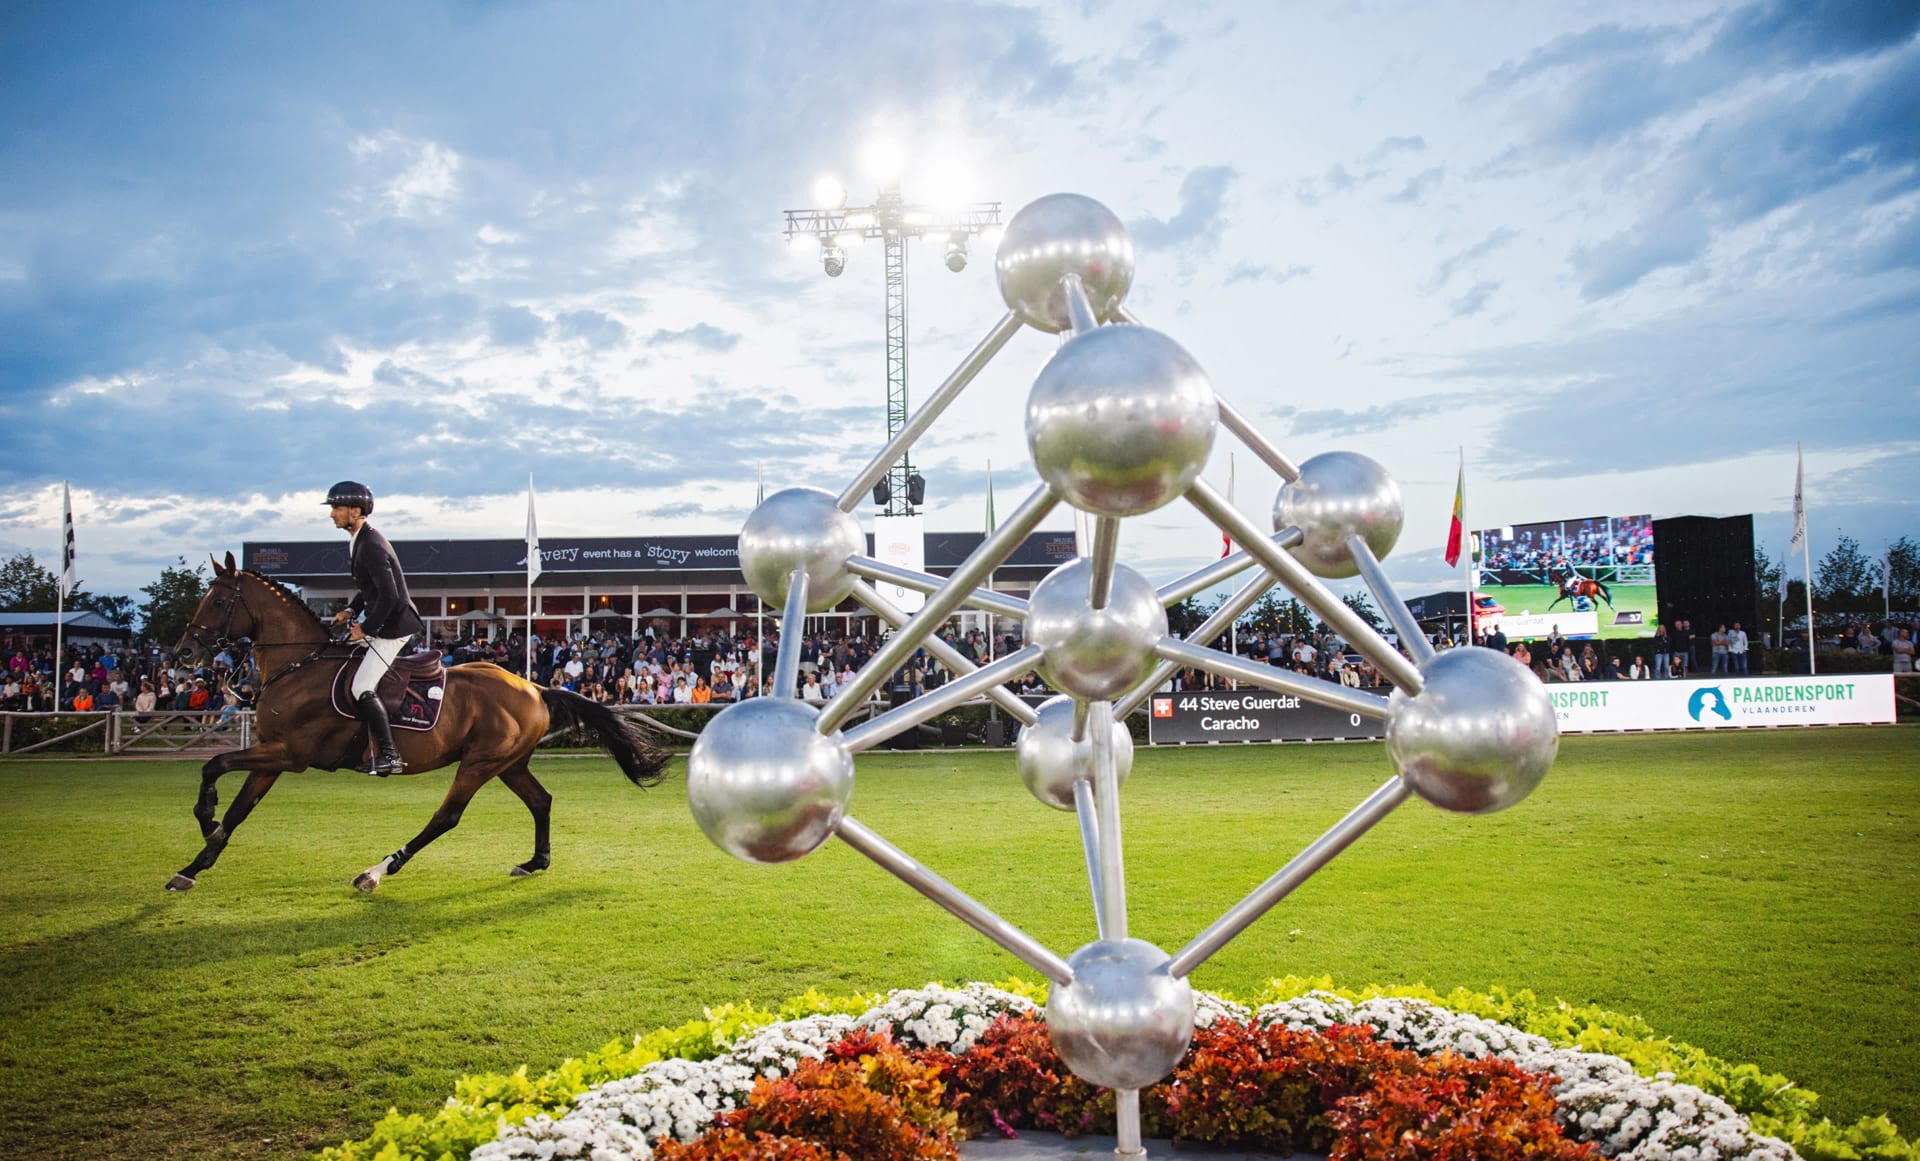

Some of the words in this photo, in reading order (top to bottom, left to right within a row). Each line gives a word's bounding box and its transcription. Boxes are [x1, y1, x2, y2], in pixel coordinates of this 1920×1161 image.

[530, 547, 579, 562] very
[583, 550, 611, 558] event
[613, 548, 632, 558] has
[634, 550, 641, 558] a
[647, 545, 691, 564] story
[1733, 683, 1855, 703] PAARDENSPORT
[1178, 697, 1199, 711] 44
[1200, 697, 1240, 711] Steve
[1242, 695, 1301, 709] Guerdat
[1742, 705, 1816, 714] VLAANDEREN
[1201, 715, 1260, 730] Caracho
[1350, 713, 1361, 727] 0
